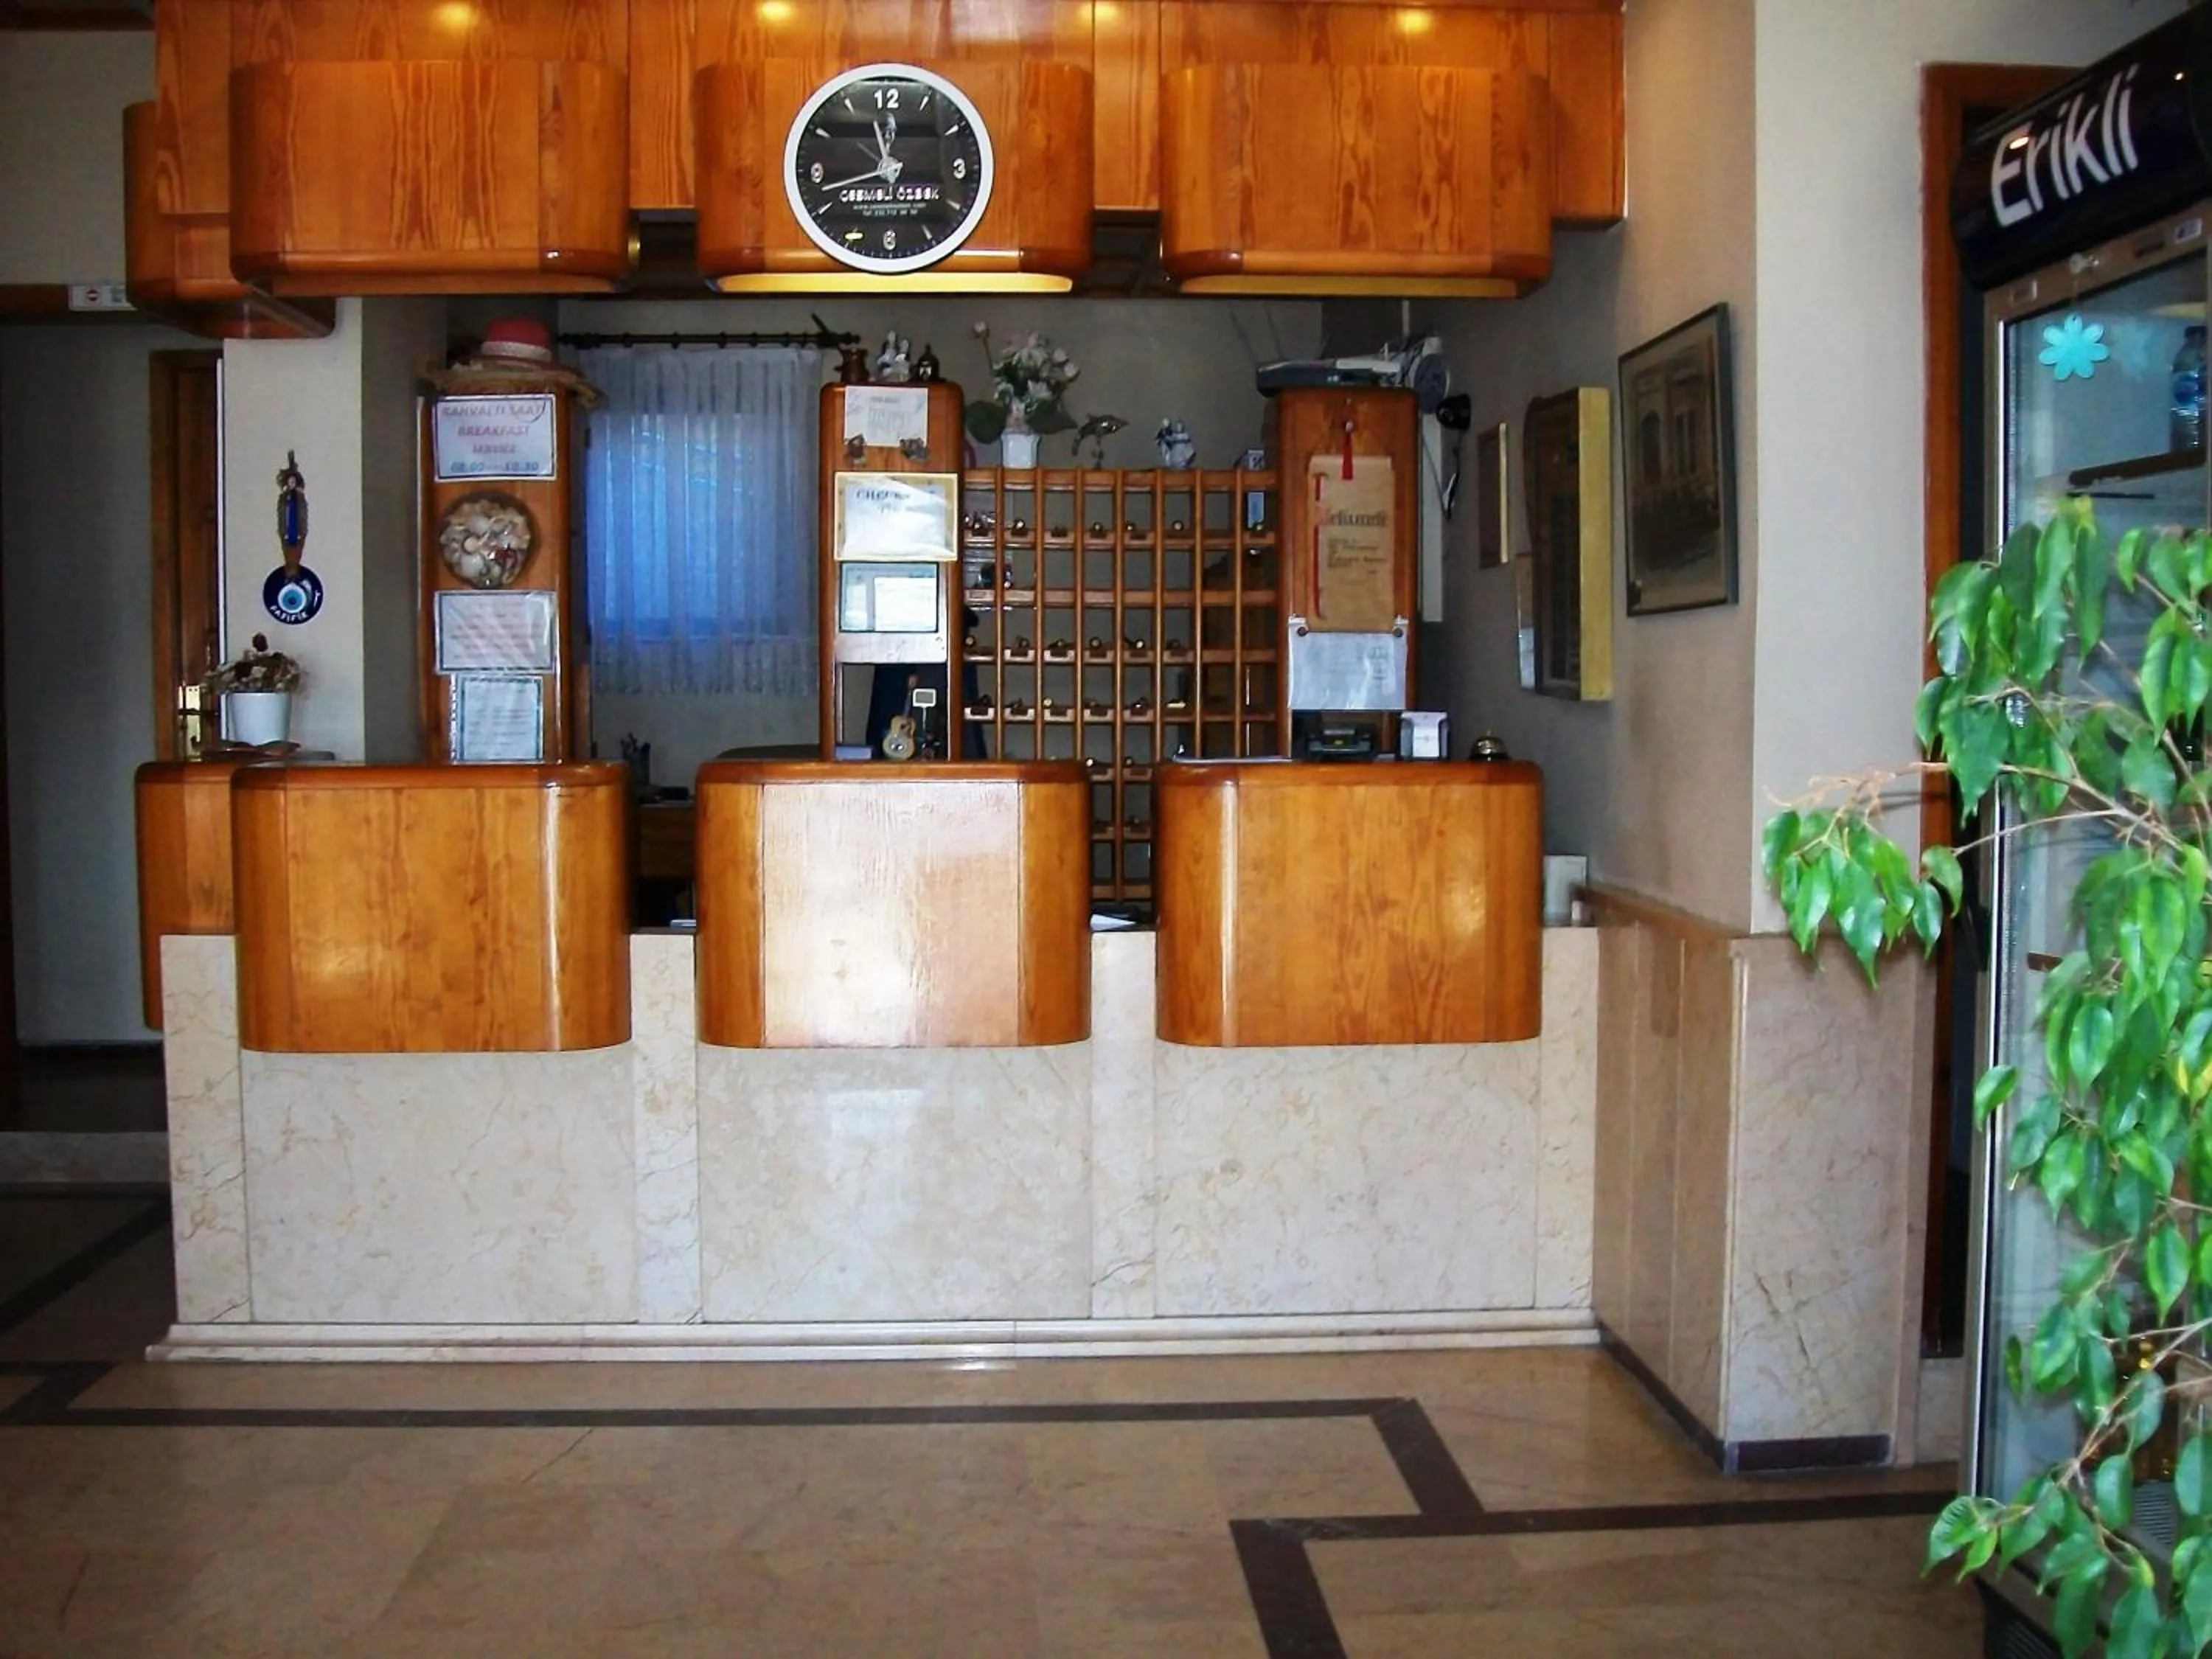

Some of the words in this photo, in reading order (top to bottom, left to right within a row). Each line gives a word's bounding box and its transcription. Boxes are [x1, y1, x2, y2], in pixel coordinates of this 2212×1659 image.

[874, 88, 899, 109] 12
[1992, 63, 2138, 227] Erikli
[810, 162, 824, 184] 9
[953, 157, 967, 179] 3
[883, 230, 897, 250] 6
